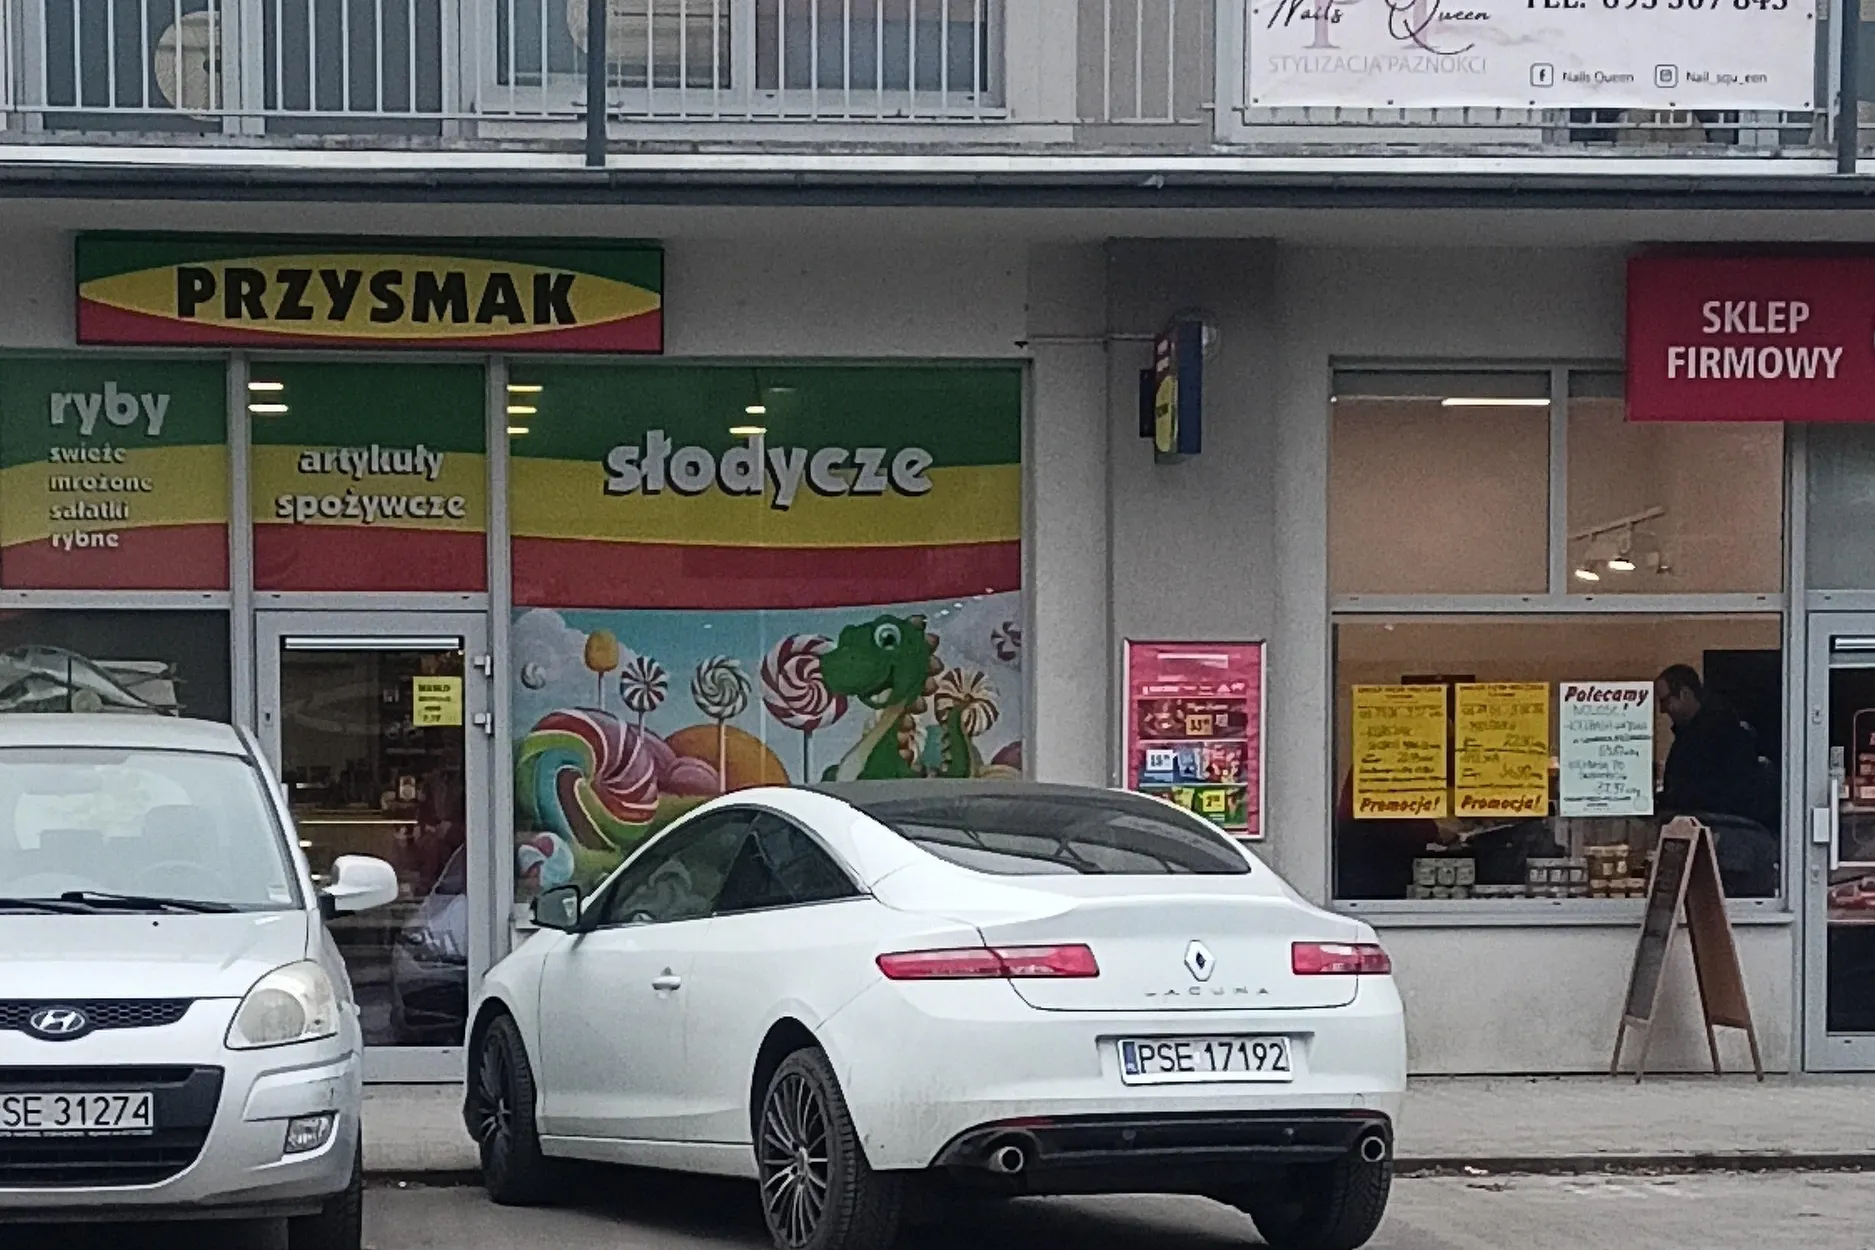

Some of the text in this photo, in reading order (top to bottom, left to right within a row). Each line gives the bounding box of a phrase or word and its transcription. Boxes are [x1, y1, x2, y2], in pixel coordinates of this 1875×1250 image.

[1268, 55, 1486, 75] STYLIZACJA PAZNOKCI
[1562, 71, 1634, 84] Nails Queen
[176, 267, 577, 325] PRZYSMAK
[1702, 301, 1810, 334] SKLEP
[1667, 346, 1843, 379] FIRMOWY
[50, 380, 170, 435] ryby
[299, 444, 444, 480] artykuły
[604, 429, 933, 510] słodycze
[50, 472, 153, 491] mrożone
[50, 500, 130, 519] sałatki
[275, 486, 466, 523] spożywcze
[52, 529, 119, 551] rybne
[1565, 686, 1649, 707] Polecamy
[1360, 796, 1440, 815] Promocja!
[1461, 794, 1542, 813] Promocja!
[1138, 1042, 1287, 1073] PSE 17192
[2, 1096, 149, 1126] SE 31274
